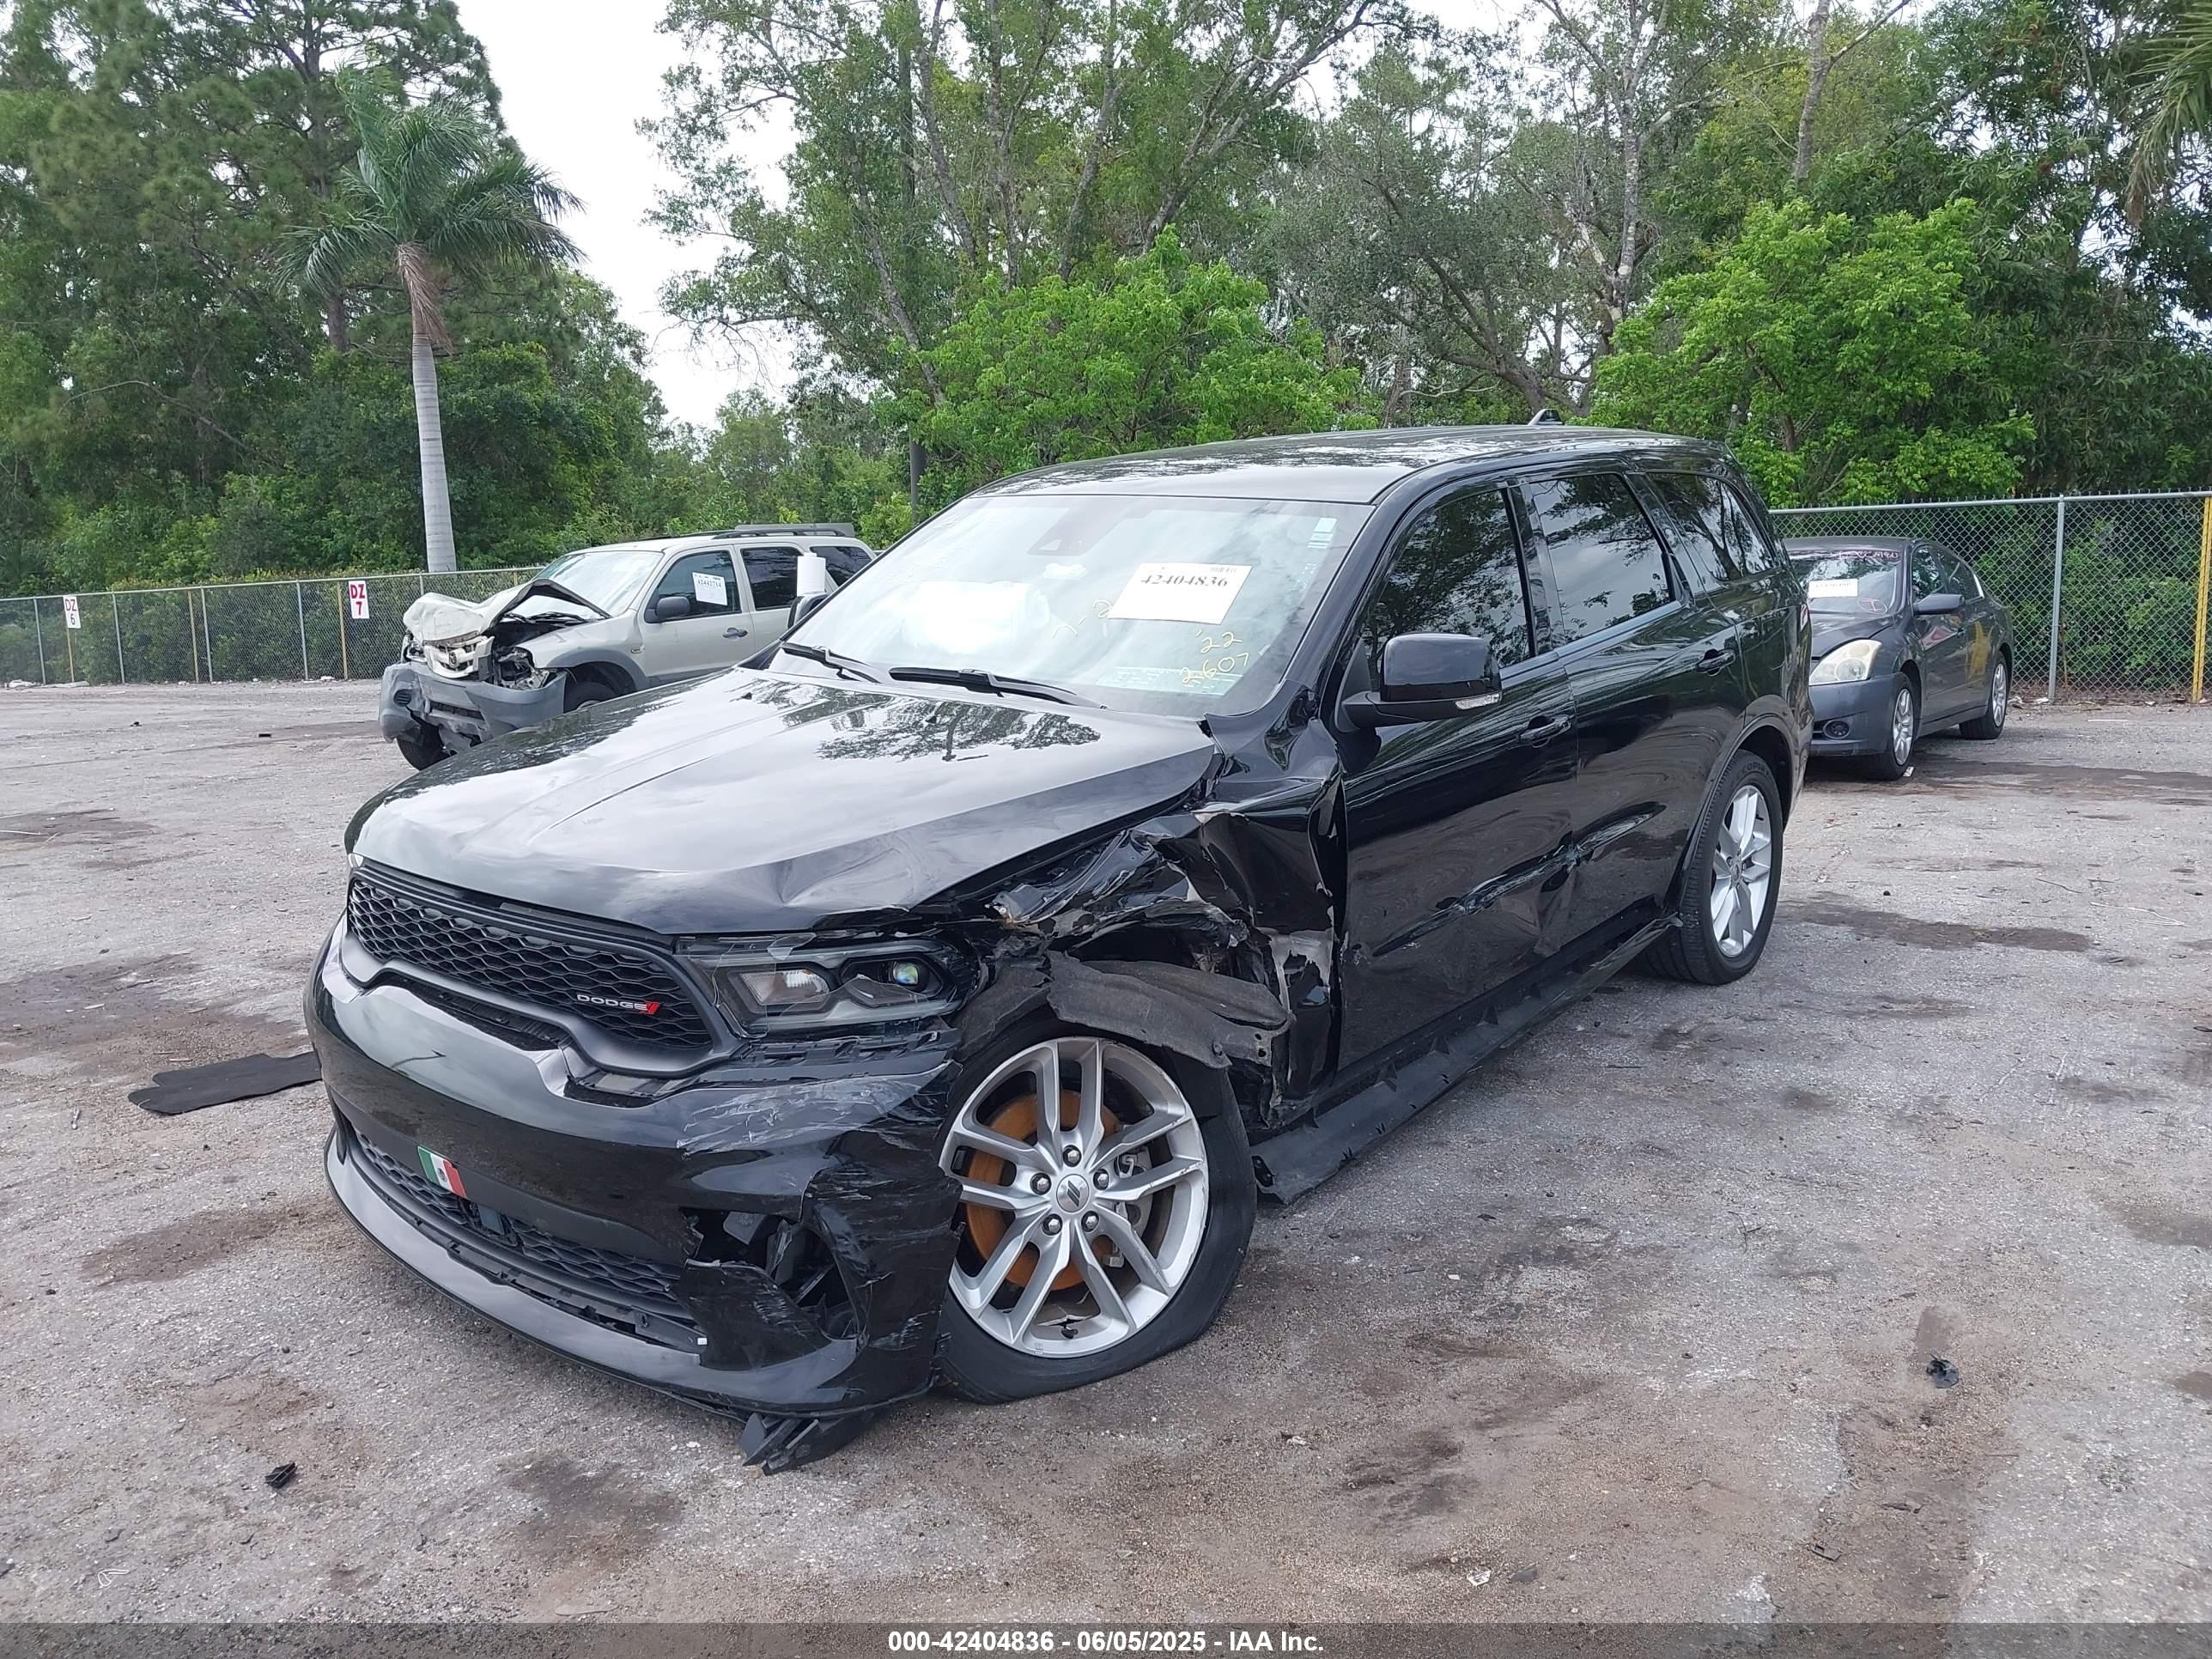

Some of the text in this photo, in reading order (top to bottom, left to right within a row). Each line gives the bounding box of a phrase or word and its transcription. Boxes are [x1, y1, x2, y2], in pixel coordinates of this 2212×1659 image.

[1140, 574, 1228, 586] 42404836
[350, 584, 366, 599] DZ
[65, 599, 76, 611] DZ
[356, 601, 362, 616] 7
[70, 613, 76, 625] 6
[576, 994, 647, 1011] DODGE
